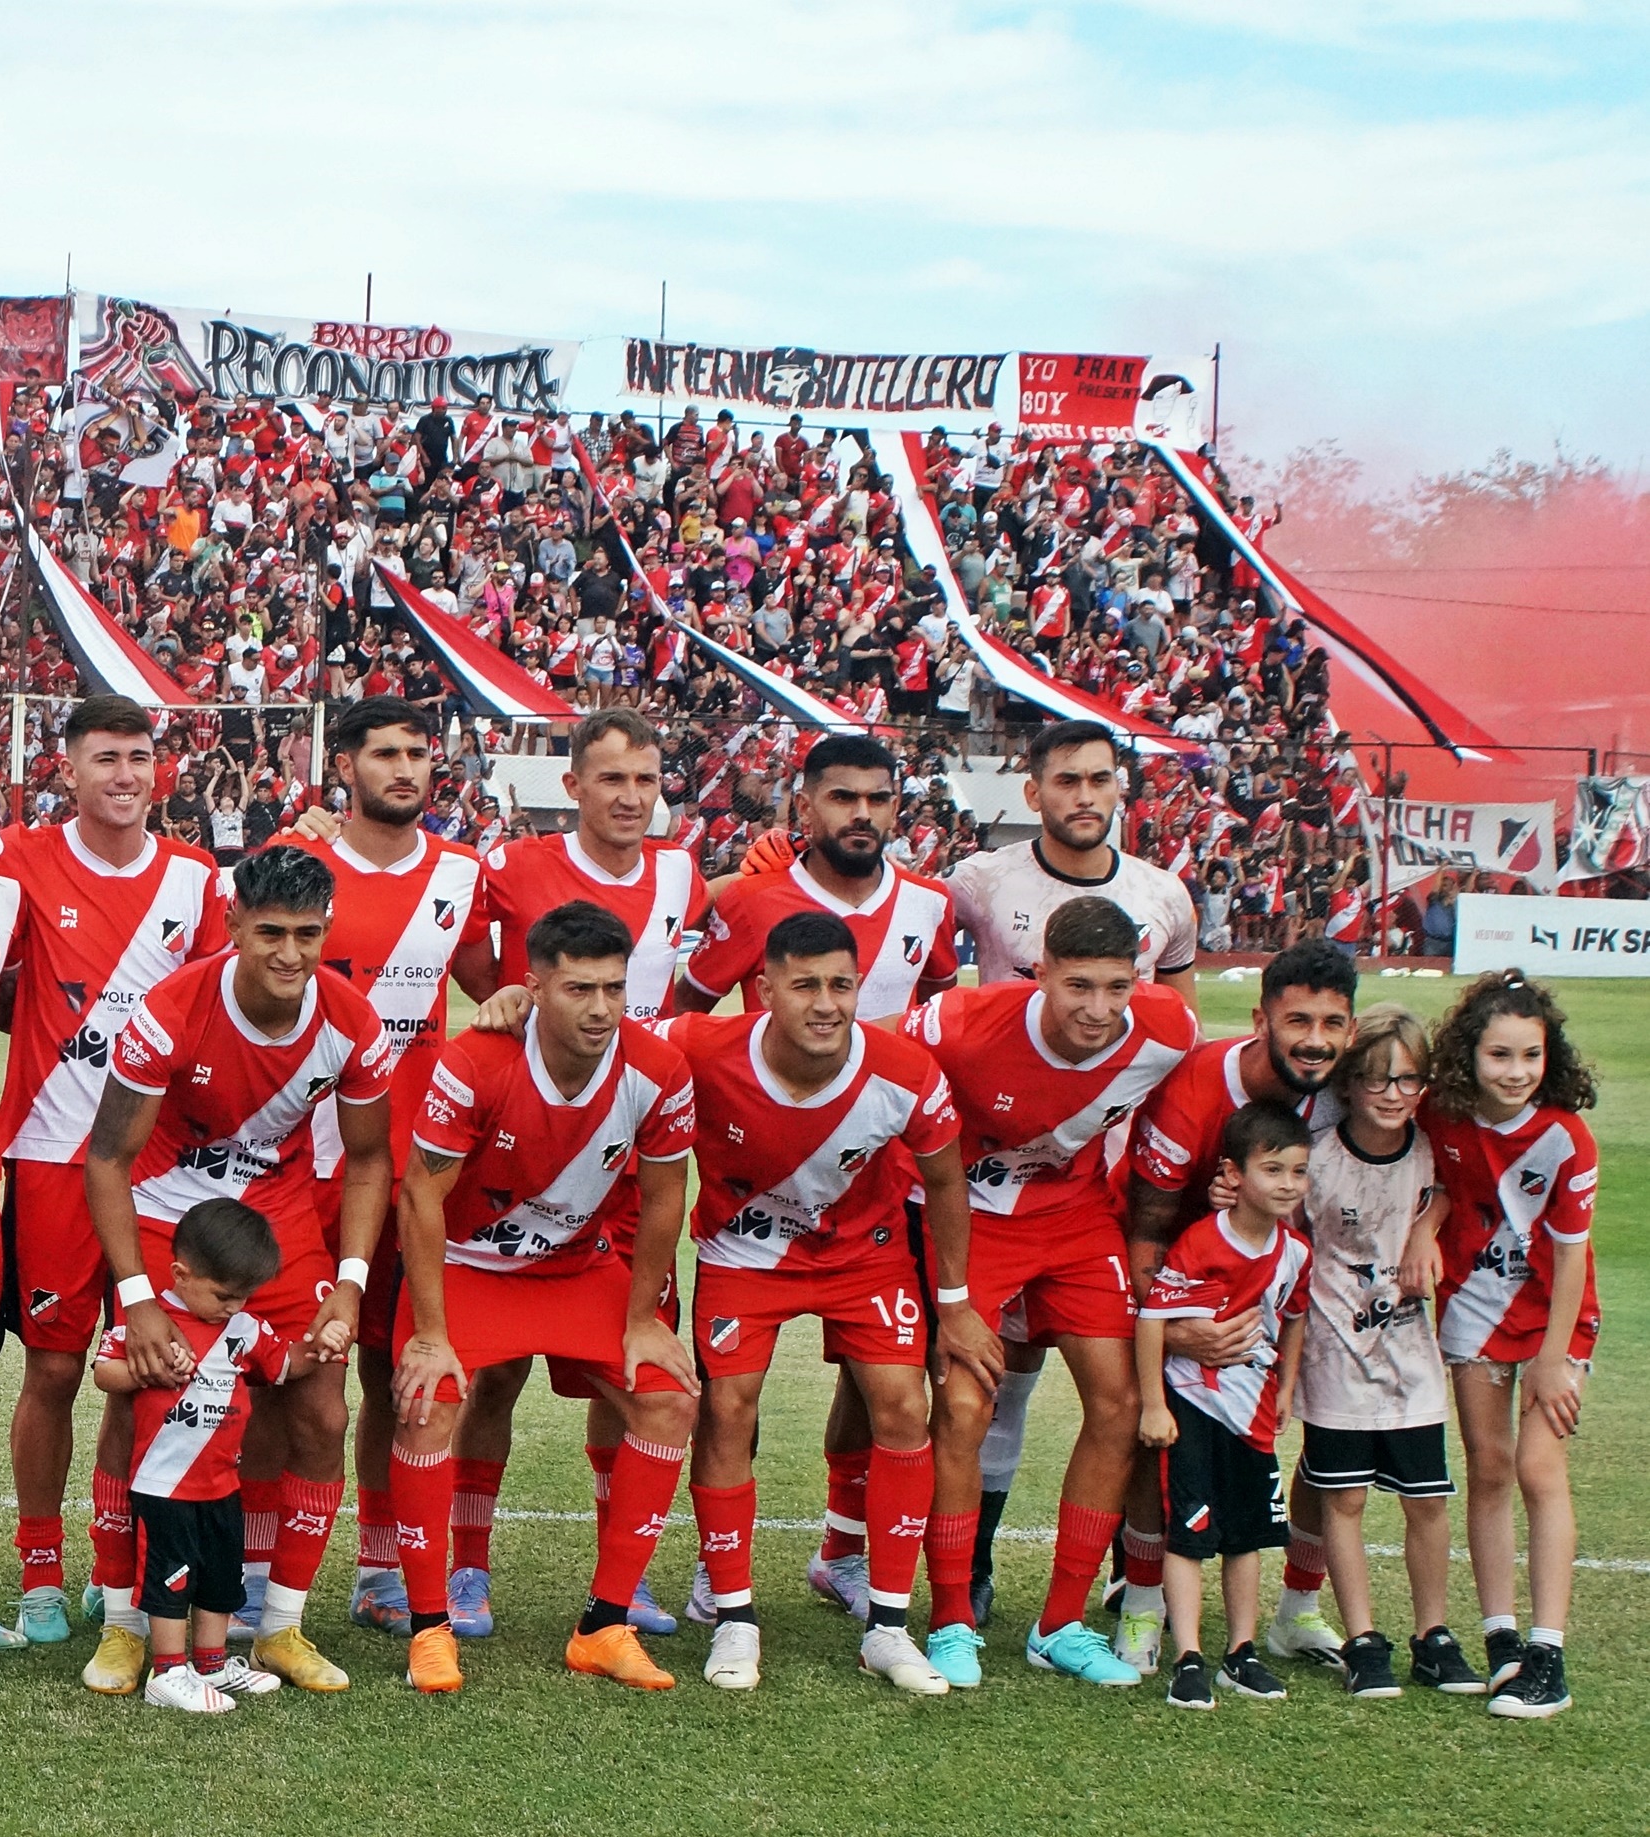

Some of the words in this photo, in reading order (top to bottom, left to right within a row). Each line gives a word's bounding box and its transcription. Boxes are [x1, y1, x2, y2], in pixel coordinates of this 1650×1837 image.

[312, 322, 452, 361] BARRIO
[205, 320, 560, 413] RECONQUISTA
[1025, 358, 1058, 381] YO
[1074, 356, 1136, 384] FRAN
[1021, 390, 1068, 416] SOY
[60, 919, 78, 928] IFK
[1572, 927, 1617, 952] IFK
[1623, 929, 1650, 953] SP
[363, 966, 399, 979] WOLF
[97, 990, 134, 1004] WOLF
[107, 1005, 129, 1015] Grupo
[634, 1006, 659, 1018] GRO
[137, 1013, 167, 1050] AccessFan
[122, 1046, 145, 1065] Vida
[192, 1076, 210, 1085] IFK
[436, 1071, 470, 1103] AccessFan
[993, 1103, 1012, 1112] IFK
[523, 1199, 561, 1217] WOLF
[1108, 1256, 1129, 1291] 1
[870, 1288, 919, 1326] 16
